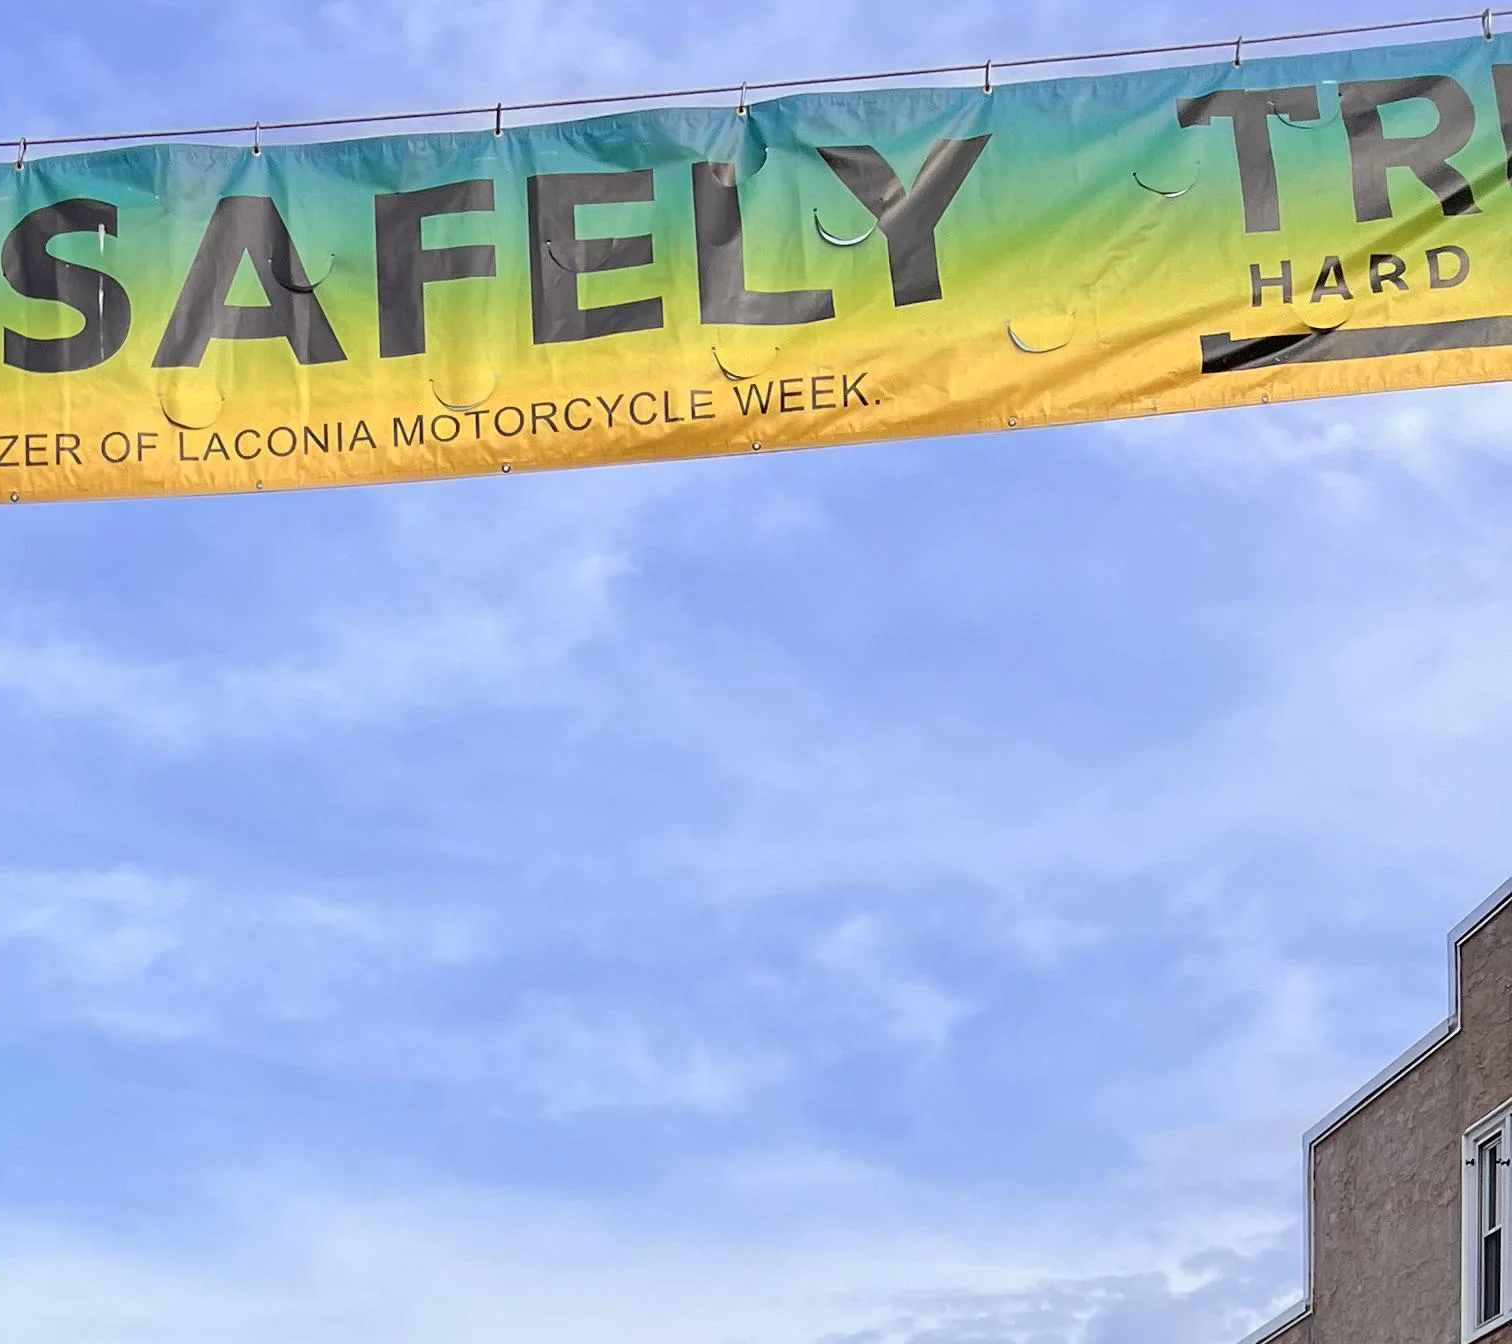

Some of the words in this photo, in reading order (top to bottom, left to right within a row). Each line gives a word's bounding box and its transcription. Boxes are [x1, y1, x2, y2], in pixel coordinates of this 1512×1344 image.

[1176, 63, 1511, 234] TR
[1, 133, 992, 373] SAFELY
[1248, 245, 1471, 308] HARD
[99, 431, 158, 464] OF
[178, 420, 379, 462] LACONIA
[391, 388, 716, 446] MOTORCYCLE
[733, 371, 882, 417] WEEK.
